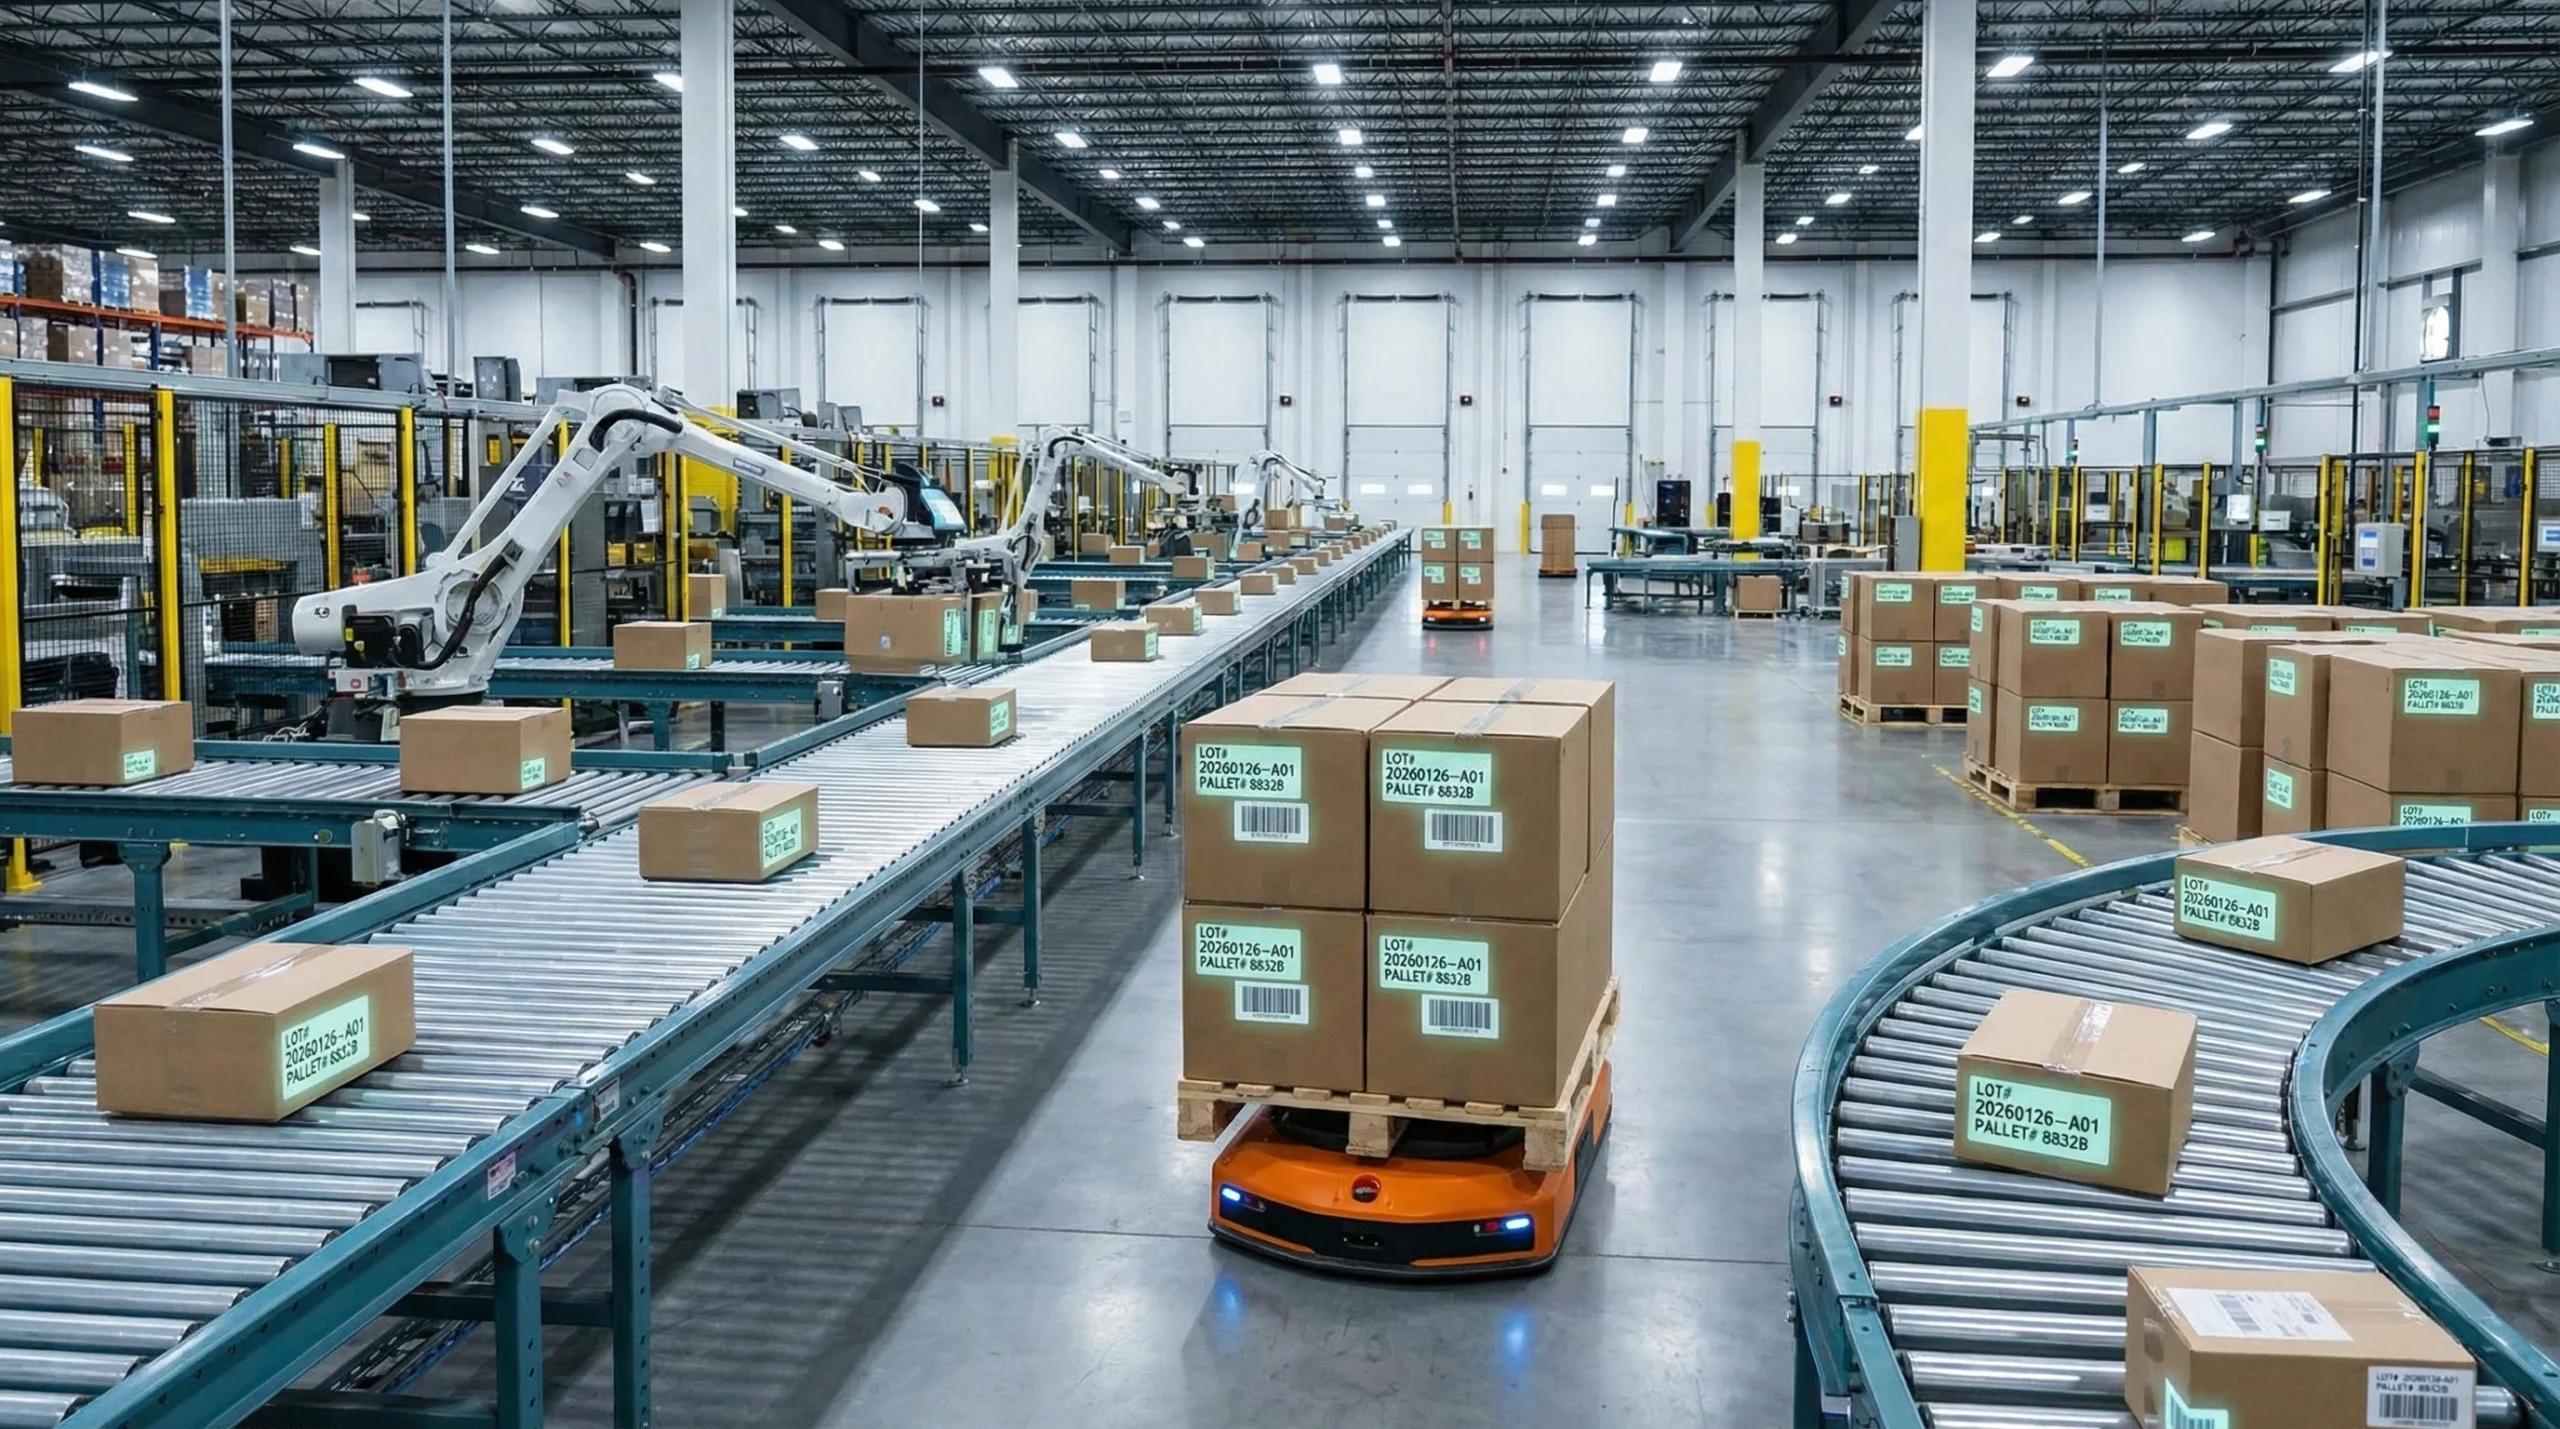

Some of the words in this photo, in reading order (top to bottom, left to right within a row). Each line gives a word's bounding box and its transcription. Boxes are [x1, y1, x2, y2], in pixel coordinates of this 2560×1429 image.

[1199, 747, 1227, 759] LOT#
[1386, 752, 1415, 765] LOT#
[1199, 760, 1294, 777] 20260126-A01
[1385, 766, 1484, 784] 20260126-A01
[1199, 776, 1247, 790] PALLET#
[1386, 782, 1434, 797] PALLET#
[2184, 890, 2268, 919] 20260126-A01
[1199, 940, 1294, 959] 20260126-A01
[1384, 952, 1481, 972] 20260126-A01
[285, 1025, 310, 1049] LOT#
[285, 1016, 364, 1069] 20260126-A01
[286, 1055, 328, 1087] PALLET#
[1976, 1081, 2012, 1100] LOT#
[1975, 1099, 2099, 1135] 20260126-A01
[1975, 1118, 2038, 1141] PALLET#
[2042, 1130, 2089, 1152] 8832B
